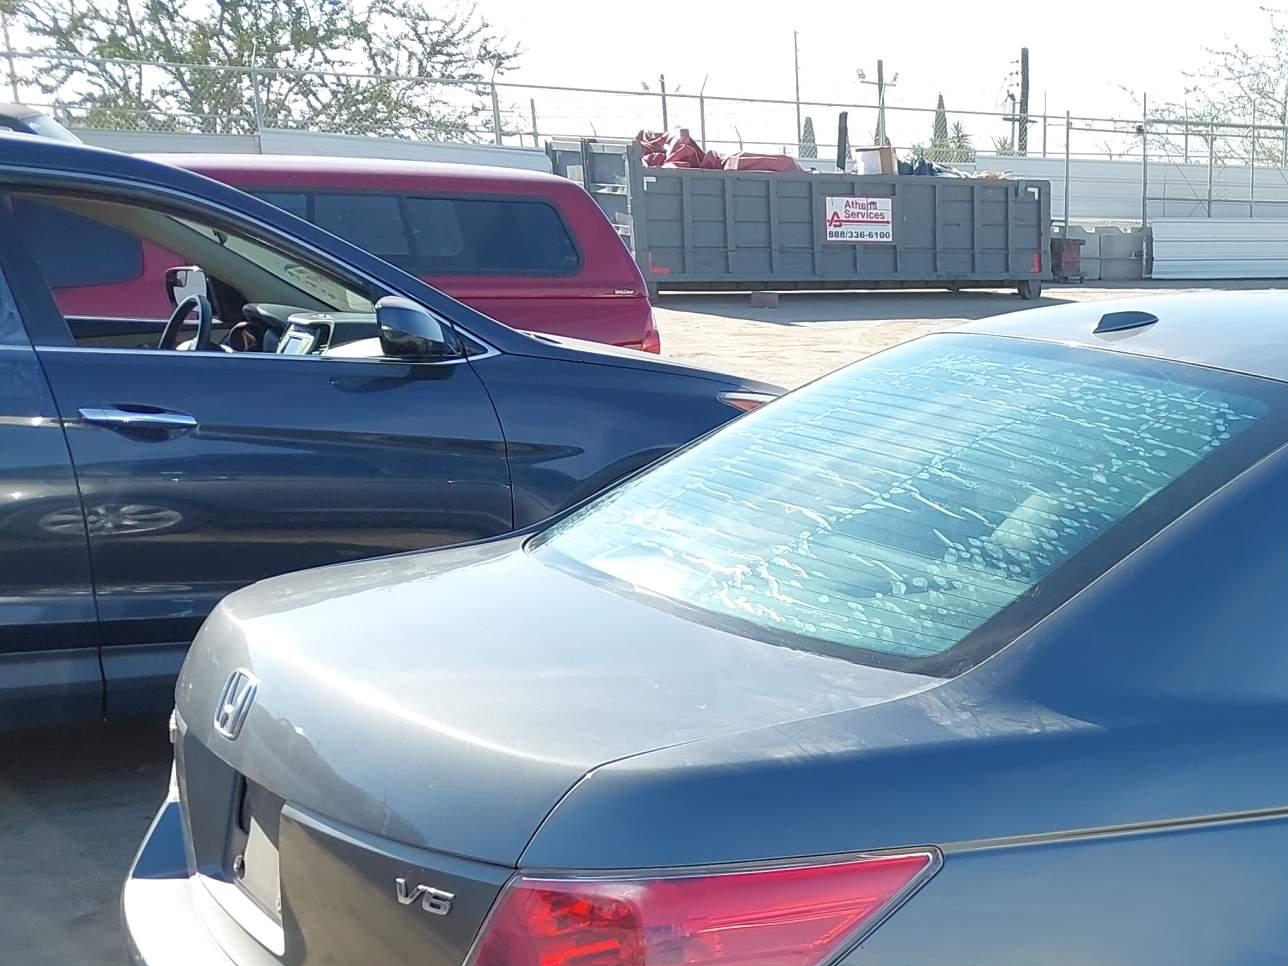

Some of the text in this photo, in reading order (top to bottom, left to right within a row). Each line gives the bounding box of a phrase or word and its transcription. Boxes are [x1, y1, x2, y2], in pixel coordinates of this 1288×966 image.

[844, 199, 878, 210] Athens
[844, 209, 886, 220] Services
[828, 230, 891, 239] 888/336-6100
[395, 877, 455, 916] V6
